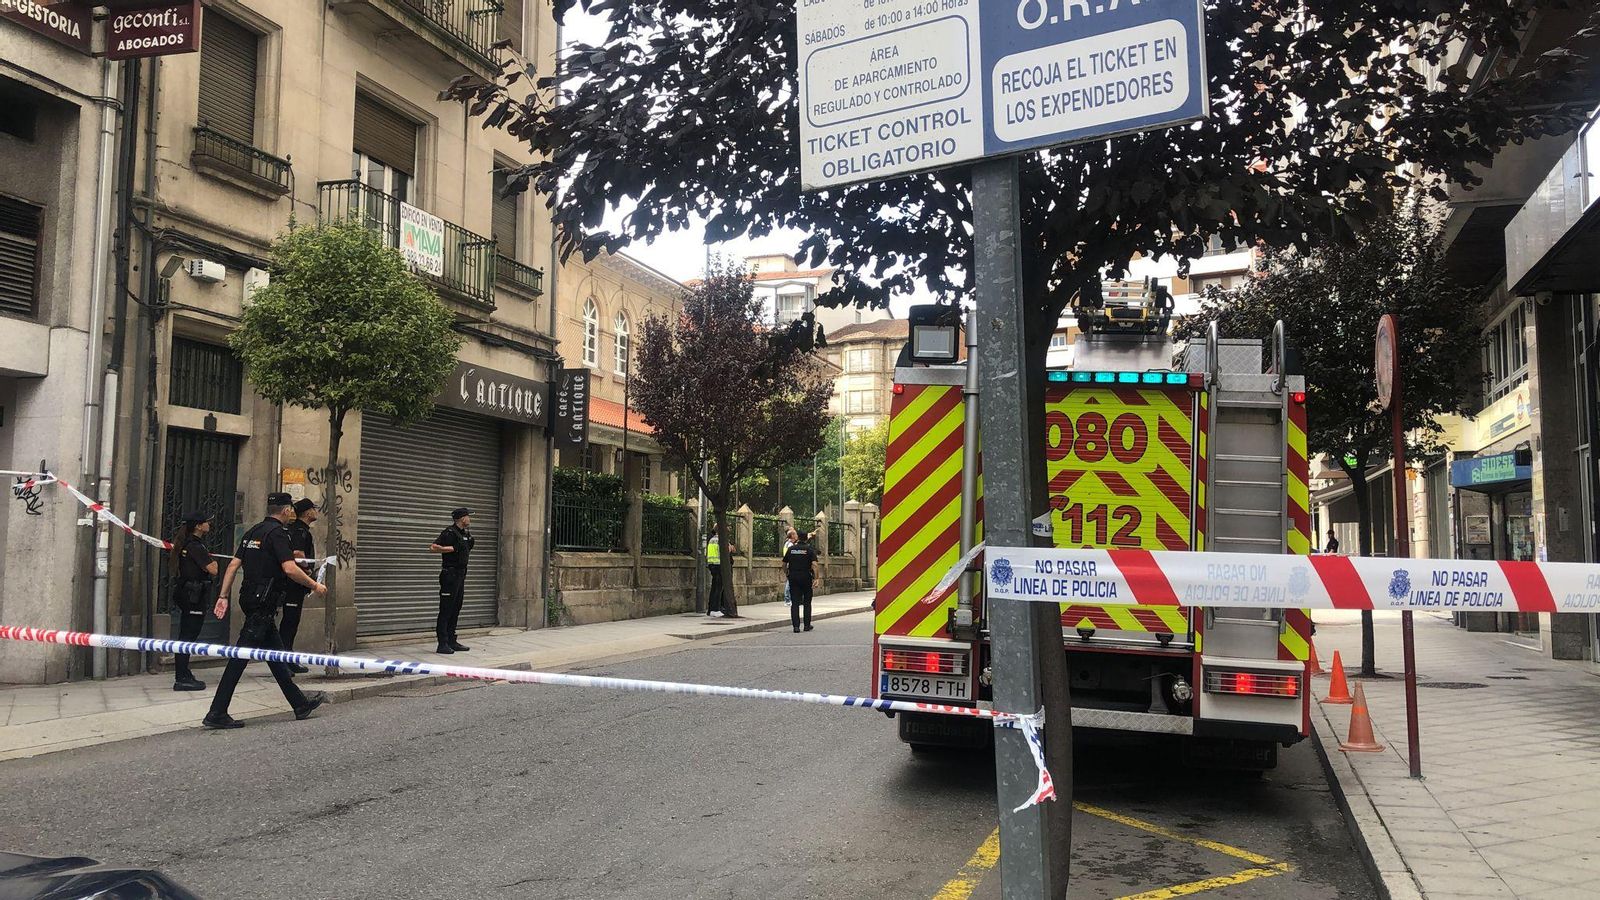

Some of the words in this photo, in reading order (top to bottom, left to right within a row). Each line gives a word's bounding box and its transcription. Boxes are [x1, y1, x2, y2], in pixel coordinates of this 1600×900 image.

[113, 8, 177, 34] geconfi
[864, 17, 875, 31] de
[878, 11, 903, 28] 10:00
[905, 10, 911, 20] a
[912, 1, 938, 18] 14:00
[941, 0, 969, 12] Horas
[117, 33, 184, 51] ABOGADOS
[870, 45, 899, 63] ÁREA
[834, 78, 849, 91] DE
[852, 57, 937, 88] APARCAMIENTO
[1001, 62, 1062, 95] RECOJA
[1067, 57, 1087, 80] EL
[1089, 42, 1148, 75] TICKET
[1154, 36, 1177, 62] EN
[813, 92, 872, 116] REGULADO
[874, 89, 882, 103] Y
[883, 72, 962, 100] CONTROLADO
[1006, 99, 1036, 125] LOS
[1041, 71, 1174, 118] EXPENDEDORES
[807, 127, 872, 155] TICKET
[878, 107, 971, 141] CONTROL
[822, 138, 956, 178] OBLIGATORIO
[556, 390, 568, 417] CAFÉ
[1046, 410, 1148, 464] 080
[1062, 502, 1142, 546] 112
[1035, 560, 1053, 574] NO
[1056, 560, 1097, 576] PASAR
[1432, 570, 1449, 586] NO
[1451, 571, 1488, 587] PASAR
[1013, 577, 1048, 596] LINEA
[1052, 579, 1068, 596] DE
[1072, 580, 1118, 598] POLICIA
[1409, 590, 1440, 606] LINEA
[1444, 591, 1459, 606] DE
[1462, 591, 1503, 607] POLICIA
[891, 677, 930, 694] 8578
[936, 680, 966, 698] FTH
